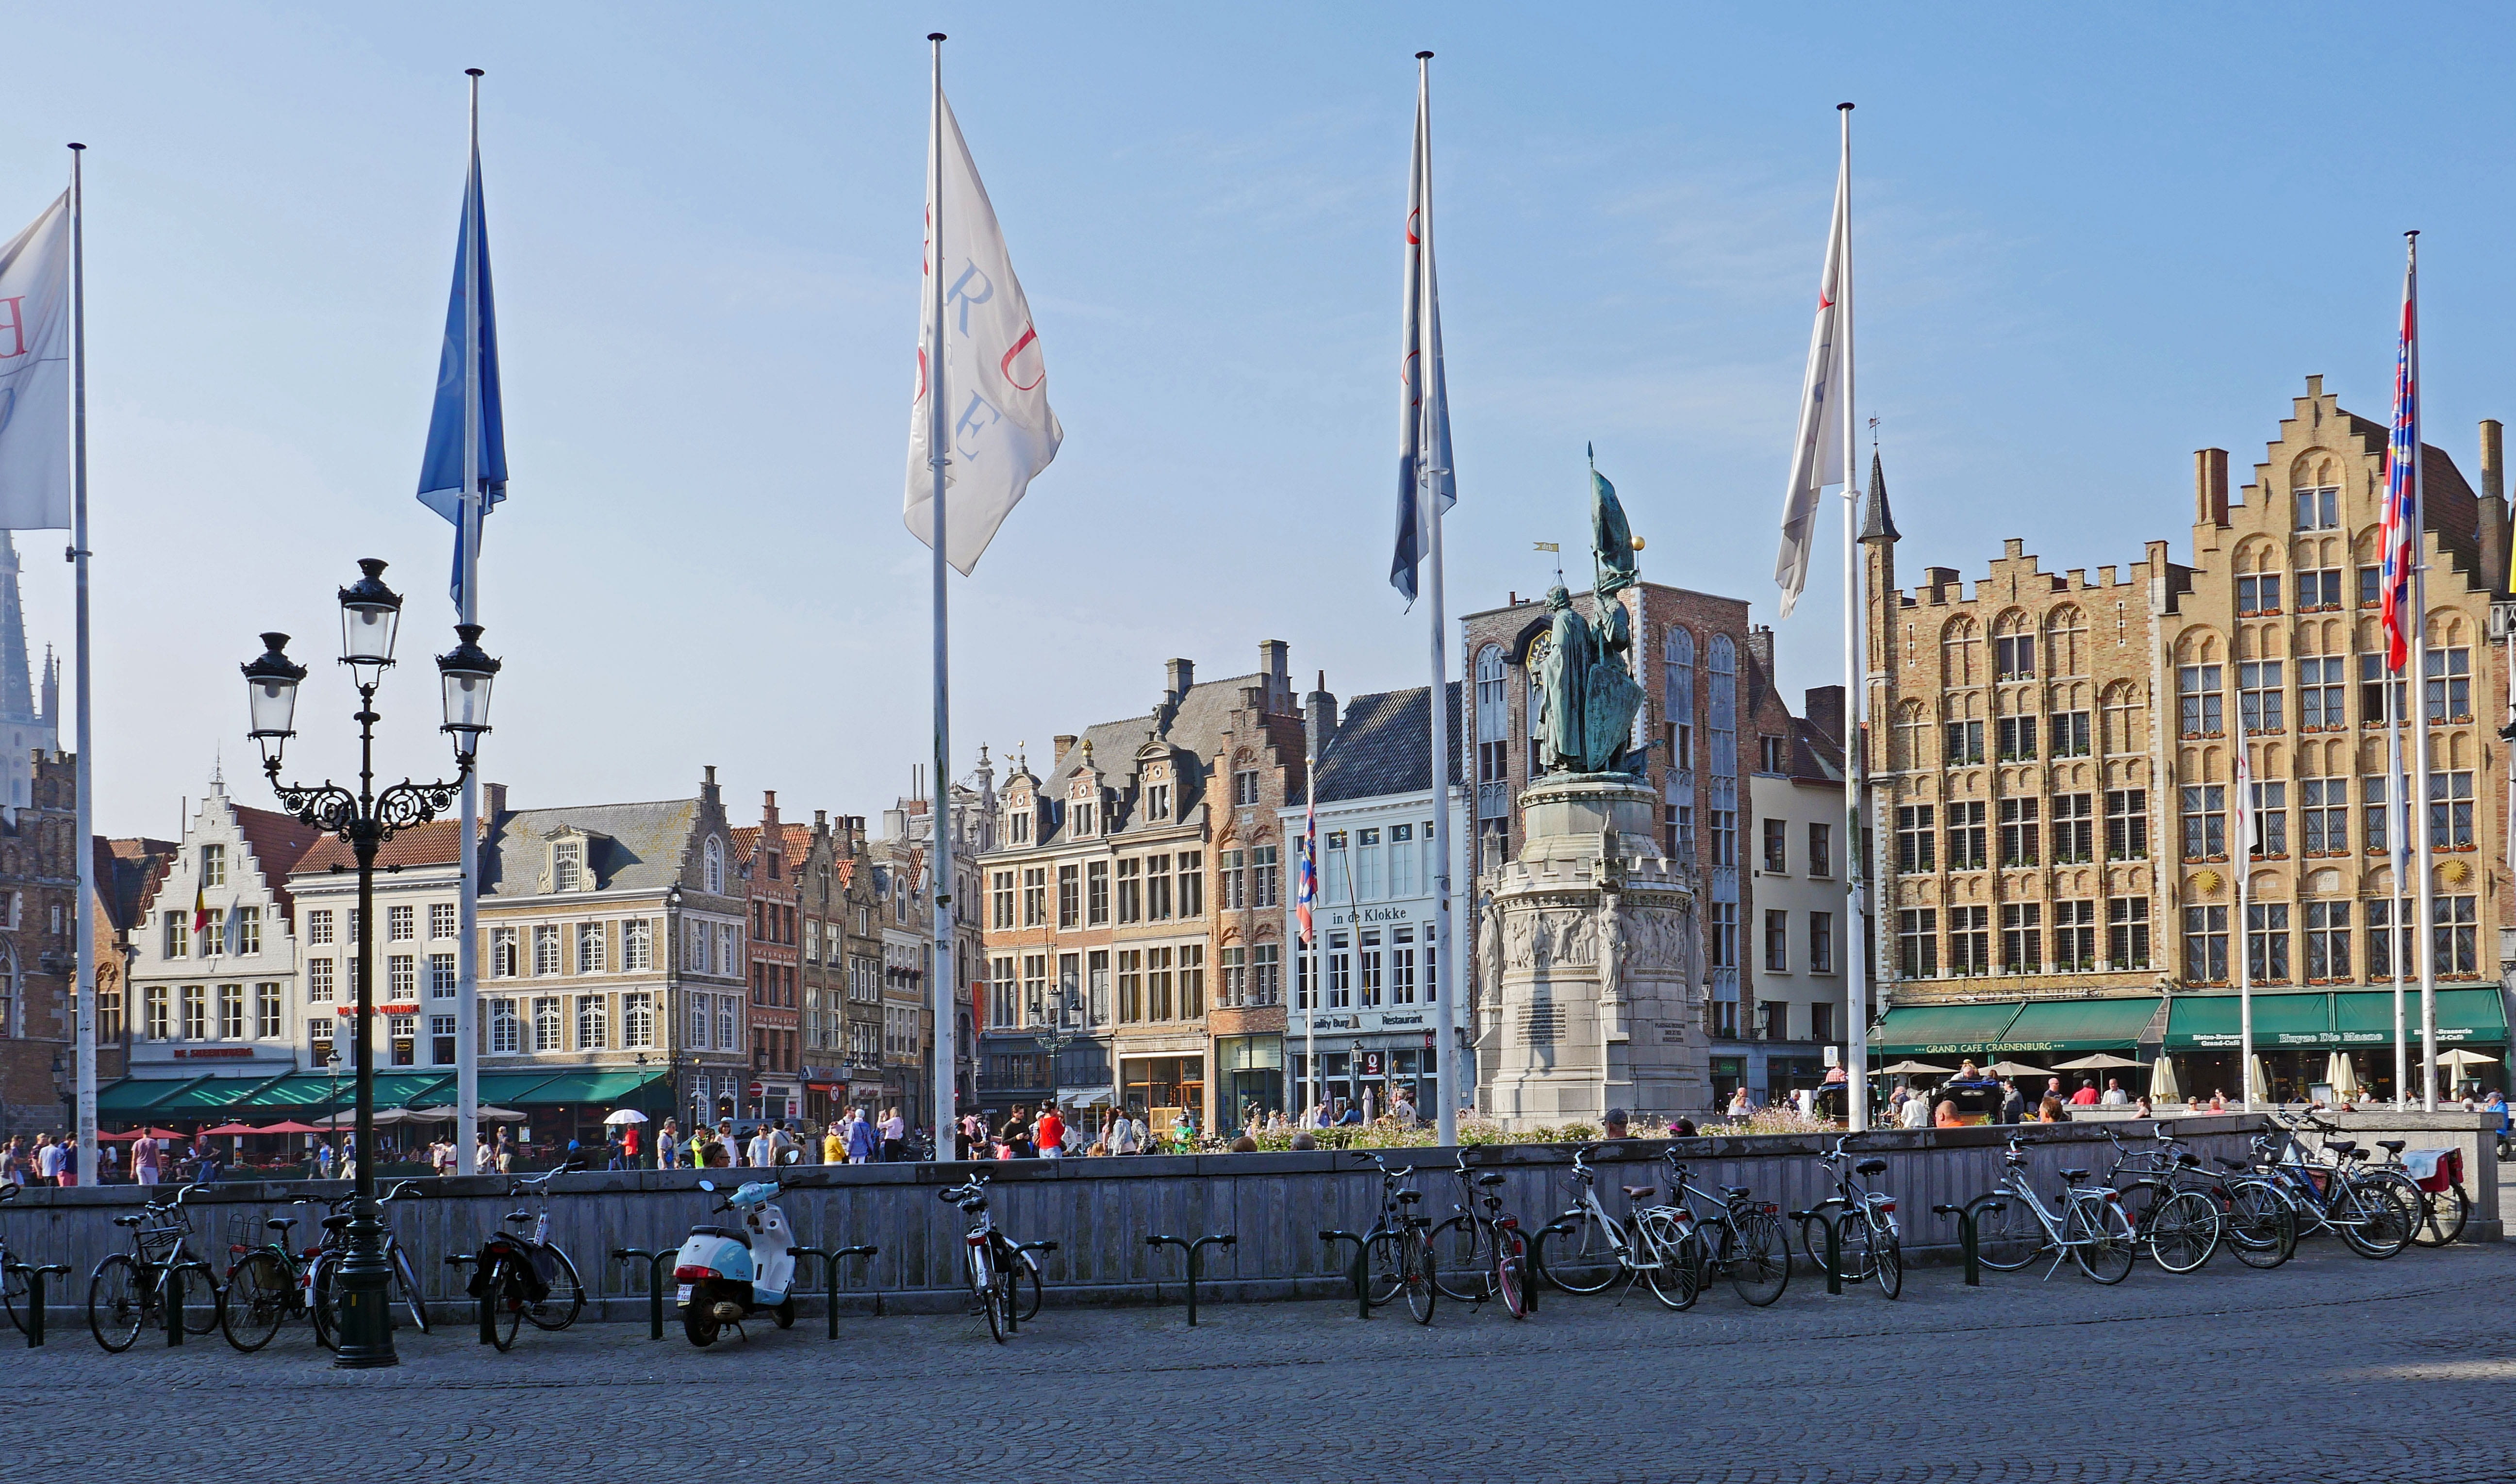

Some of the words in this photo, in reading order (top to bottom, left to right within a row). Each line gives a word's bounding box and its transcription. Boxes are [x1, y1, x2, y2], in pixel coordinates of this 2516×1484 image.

[1333, 913, 1343, 924] in
[1348, 911, 1360, 923] de
[1365, 907, 1406, 922] Klokke
[337, 1006, 349, 1015] DE
[380, 1005, 420, 1013] WINDEN
[1306, 1019, 1331, 1029] ality
[1333, 1019, 1350, 1029] Burg
[1382, 1015, 1423, 1025] Restaurant
[2279, 1034, 2317, 1044] Huyze
[2320, 1033, 2340, 1042] Die
[2343, 1033, 2383, 1041] Maene
[1926, 1045, 1956, 1053] GRAND
[1986, 1042, 2052, 1052] CRAENENBURG
[1368, 1054, 1377, 1068] Q
